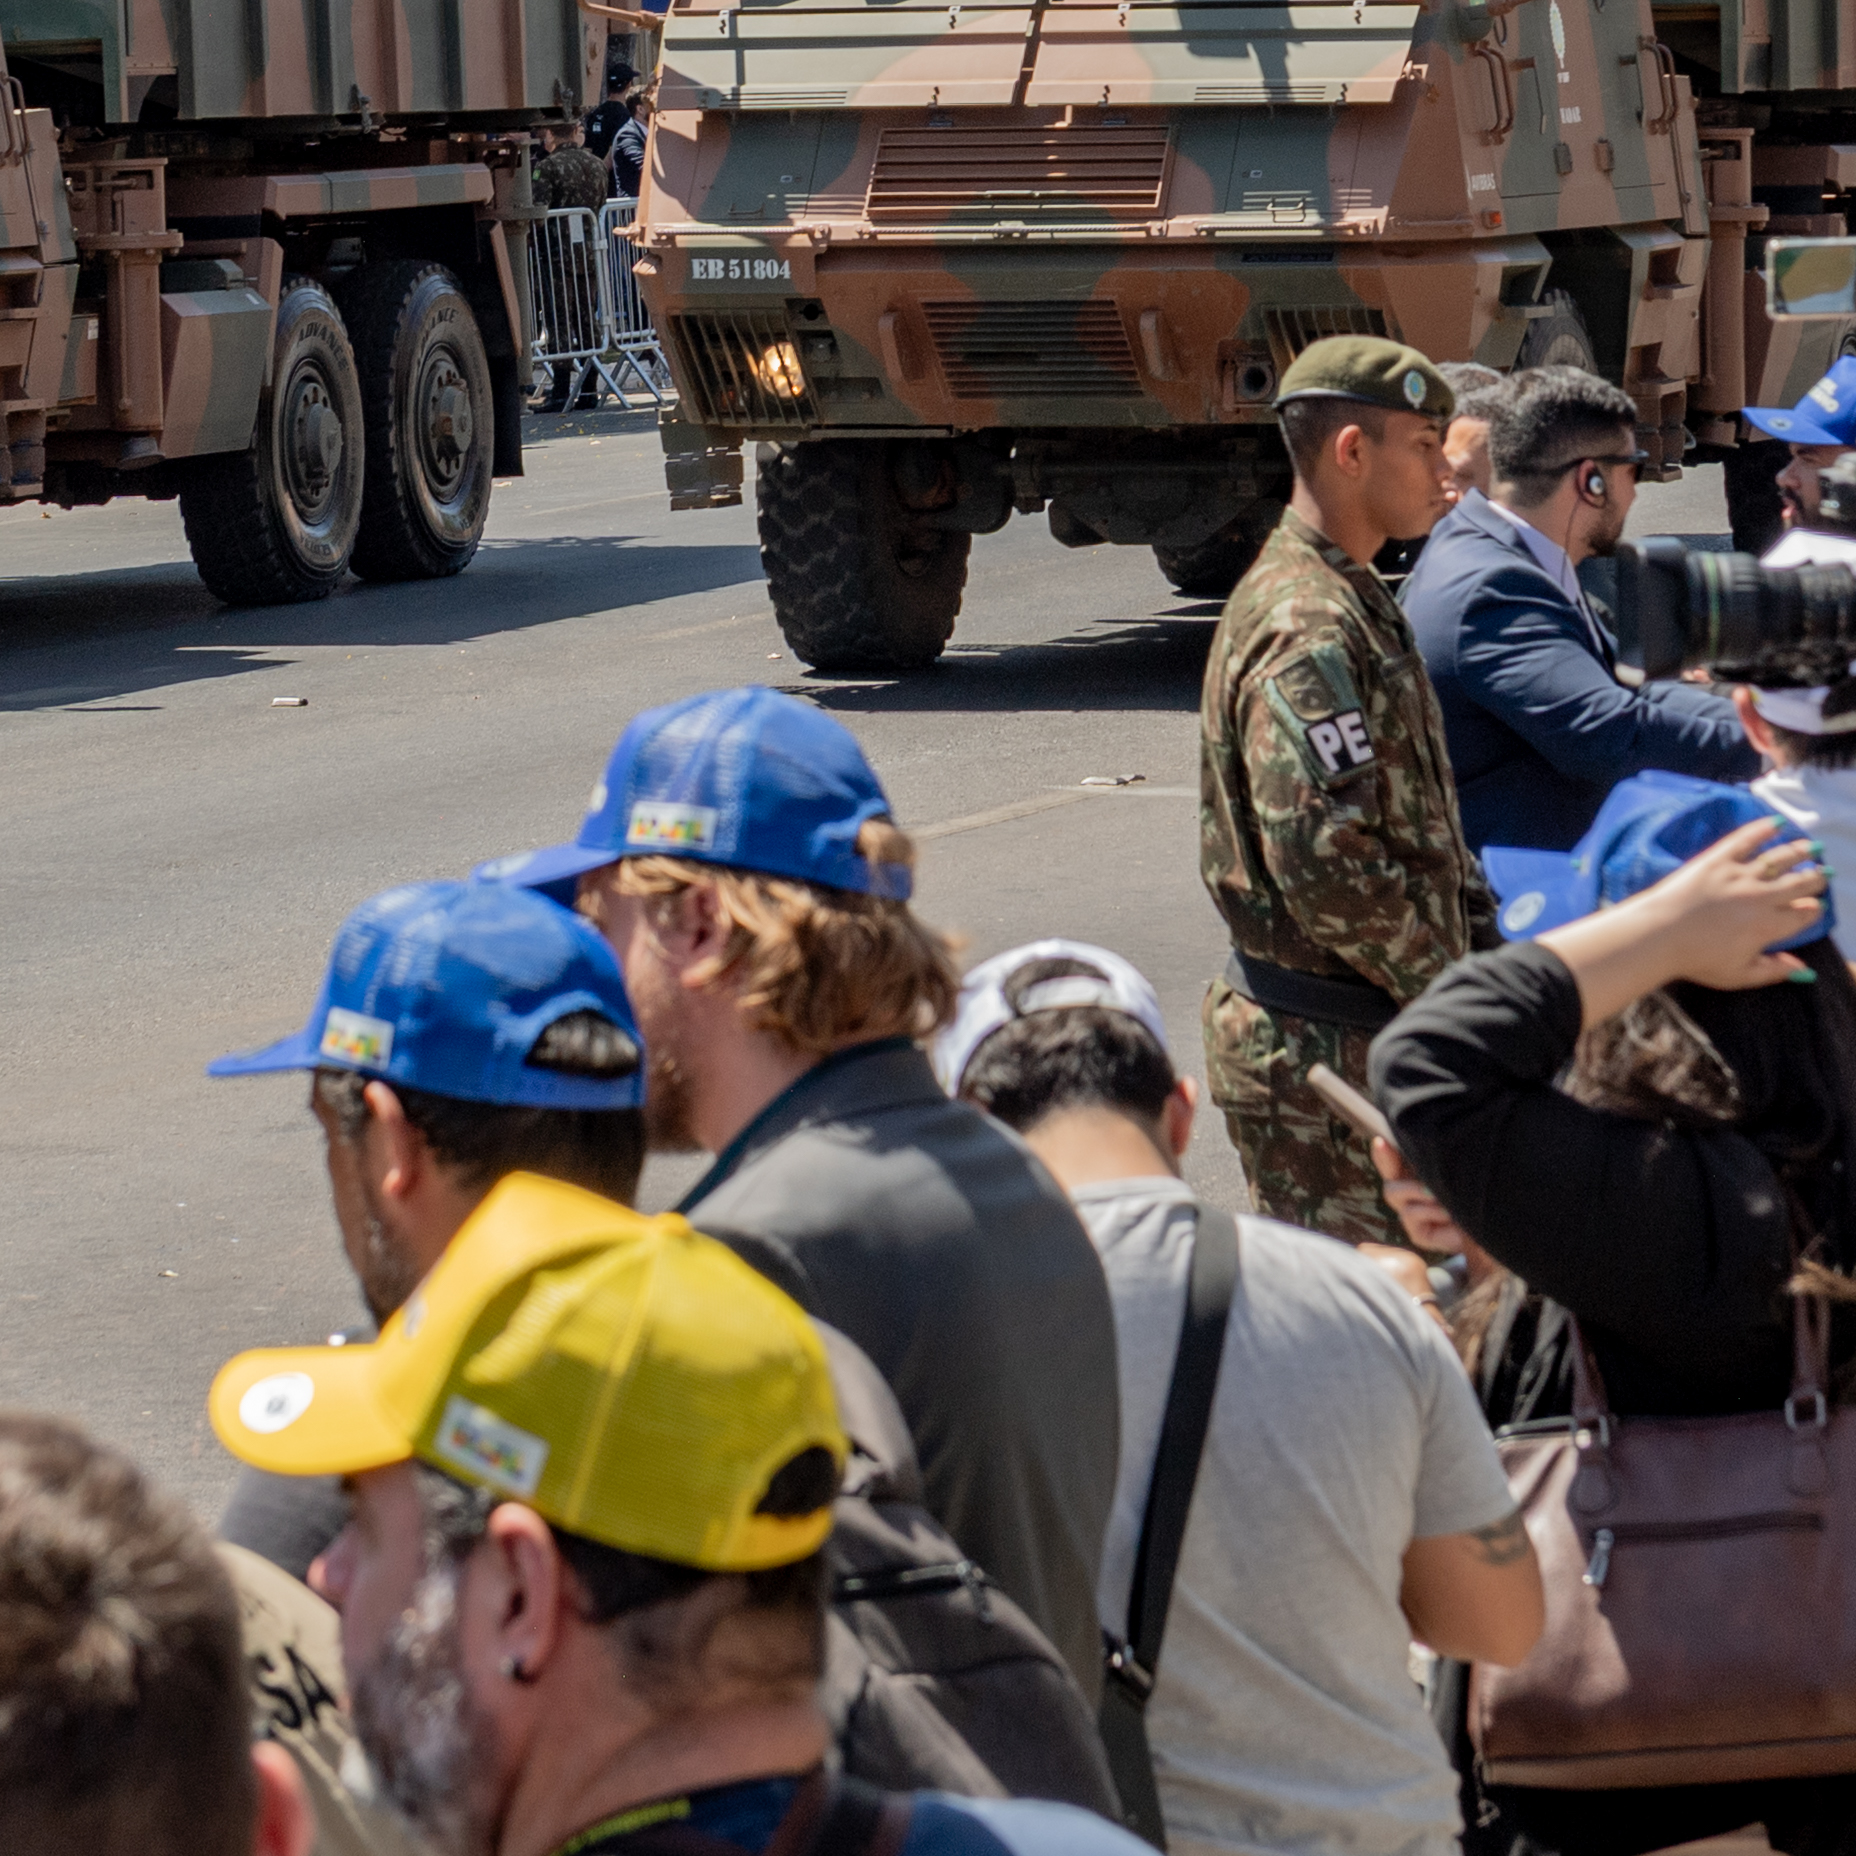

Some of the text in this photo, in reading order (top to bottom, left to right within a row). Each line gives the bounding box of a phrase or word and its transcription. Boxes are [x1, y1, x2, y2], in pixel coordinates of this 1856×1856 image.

[691, 258, 791, 279] EB 51804
[1307, 711, 1375, 773] PE
